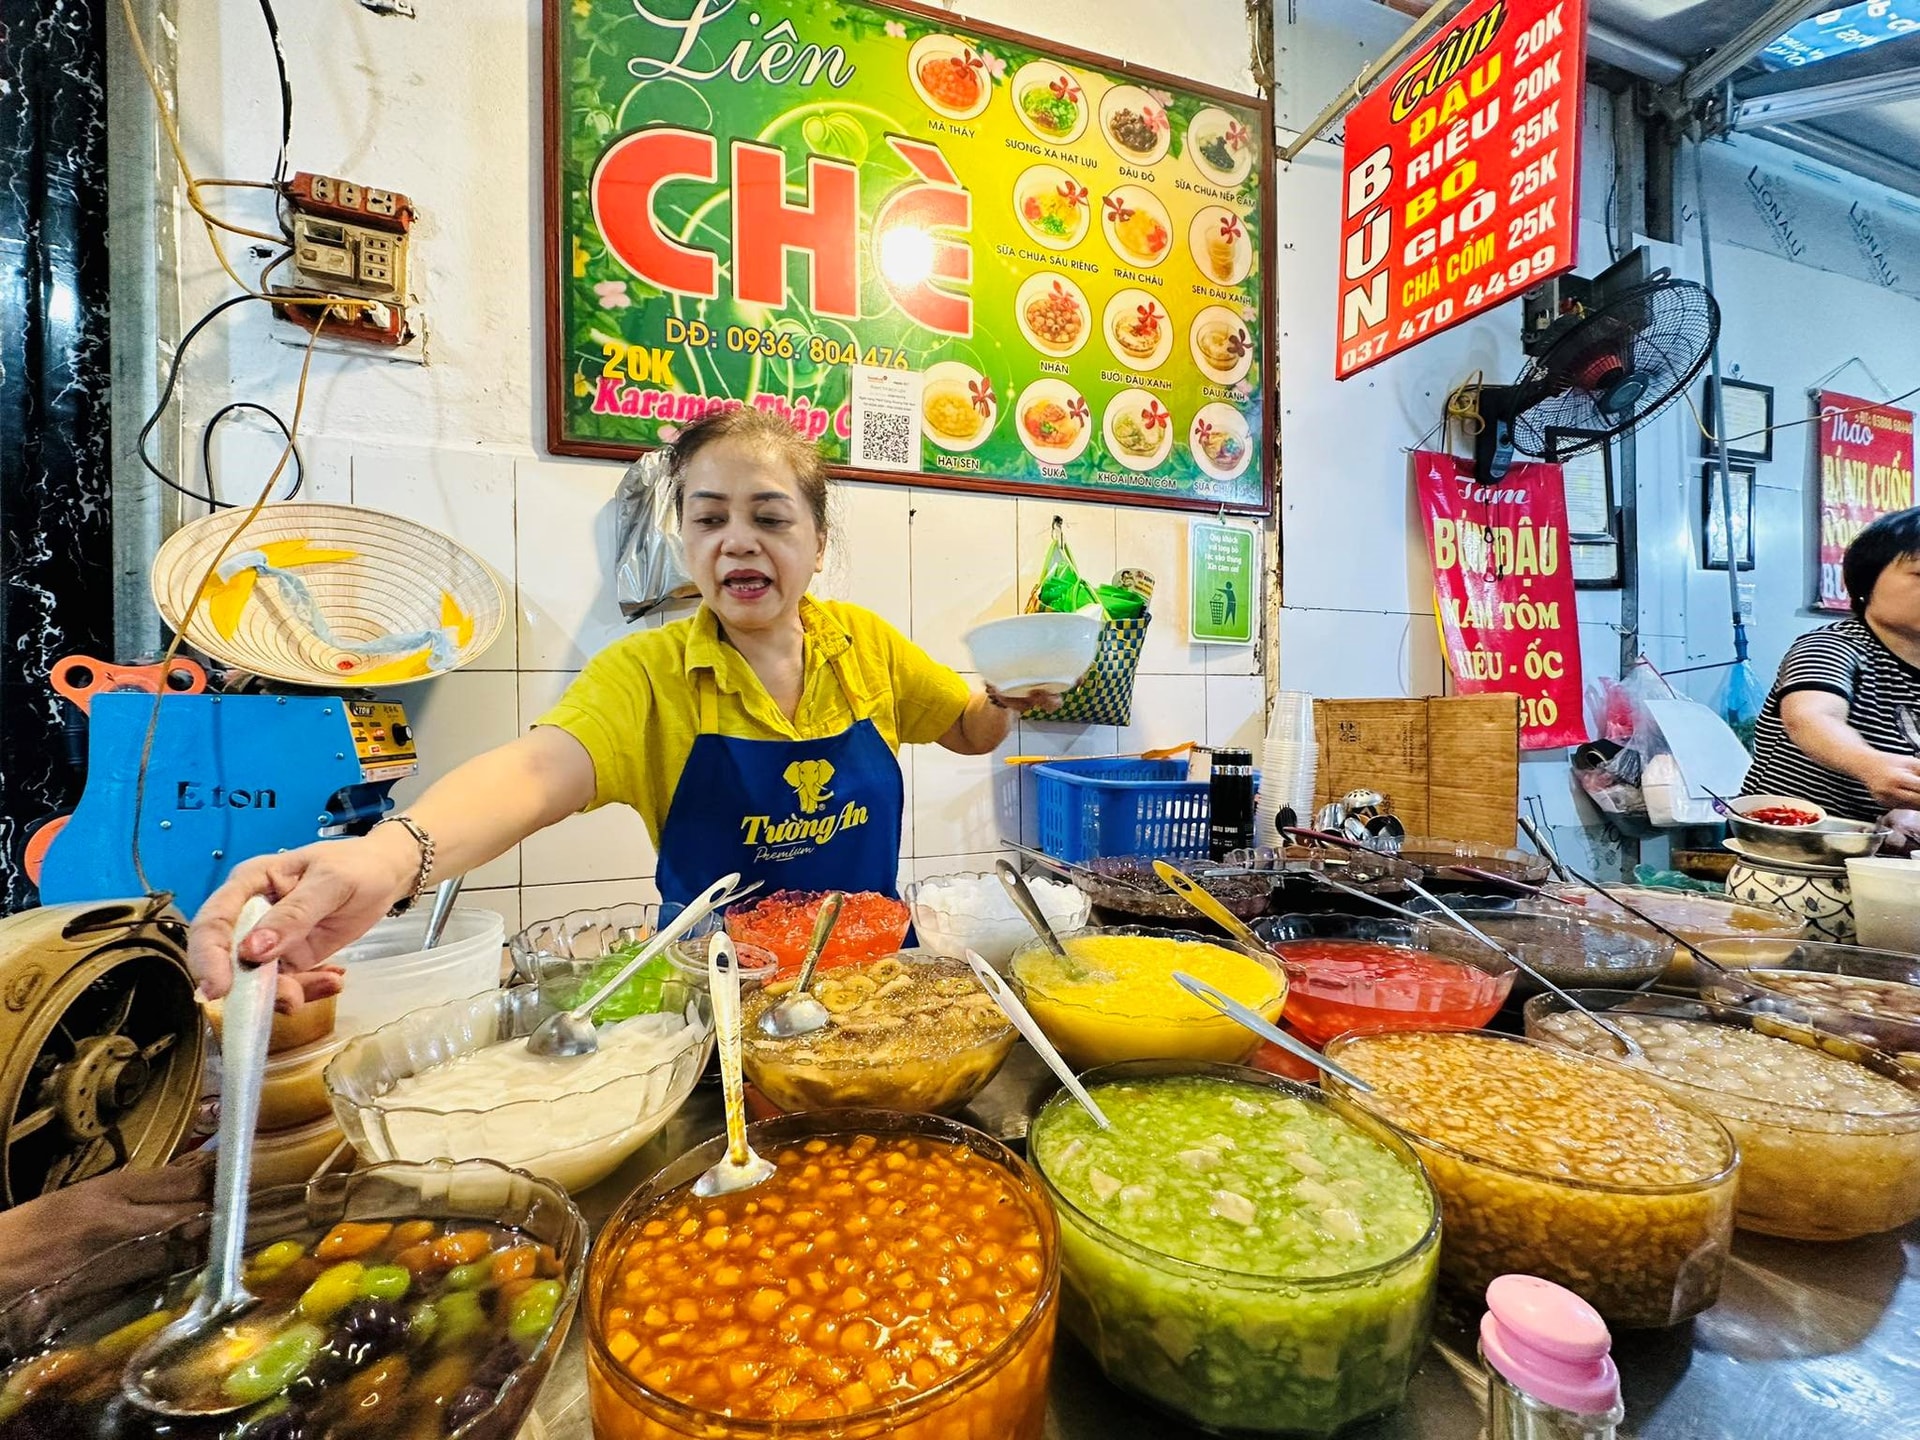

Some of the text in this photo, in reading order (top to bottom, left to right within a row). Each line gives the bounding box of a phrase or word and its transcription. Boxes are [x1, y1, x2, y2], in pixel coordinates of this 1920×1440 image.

[628, 0, 856, 88] Liên
[1390, 1, 1508, 124] Tâm
[1409, 52, 1501, 148] ĐẬU
[1514, 1, 1564, 68] 20K
[1407, 97, 1500, 189] RIÊU
[1512, 51, 1562, 114] 20K
[1044, 148, 1058, 159] XA
[1119, 166, 1155, 183] ĐẬU ĐỎ
[1405, 97, 1560, 229] BÒ 35K
[1194, 185, 1218, 198] CHUA
[1403, 148, 1558, 268] GIÒ 25K
[589, 123, 973, 339] CHÈ
[1342, 143, 1393, 343] BÚN
[1402, 196, 1557, 308] CHẢ CỐM 25K
[1019, 249, 1046, 263] CHUA
[1192, 285, 1207, 295] SEN
[1341, 245, 1556, 372] 037 470 4499
[602, 341, 676, 386] 20K
[665, 317, 909, 370] DĐ: 0936. 804 476
[1147, 378, 1172, 389] XANH
[1222, 391, 1245, 401] XANH
[960, 458, 979, 469] SEN
[1042, 466, 1067, 478] SUKA
[1098, 472, 1127, 484] KHOAI
[1823, 445, 1911, 512] BÁNH CUỐN
[1492, 517, 1558, 587] ĐẬU
[1500, 593, 1560, 630] TÔM
[1524, 637, 1565, 679] ỐC
[177, 781, 276, 810] Eton
[740, 801, 868, 845] Tường An
[754, 846, 814, 863] Premium
